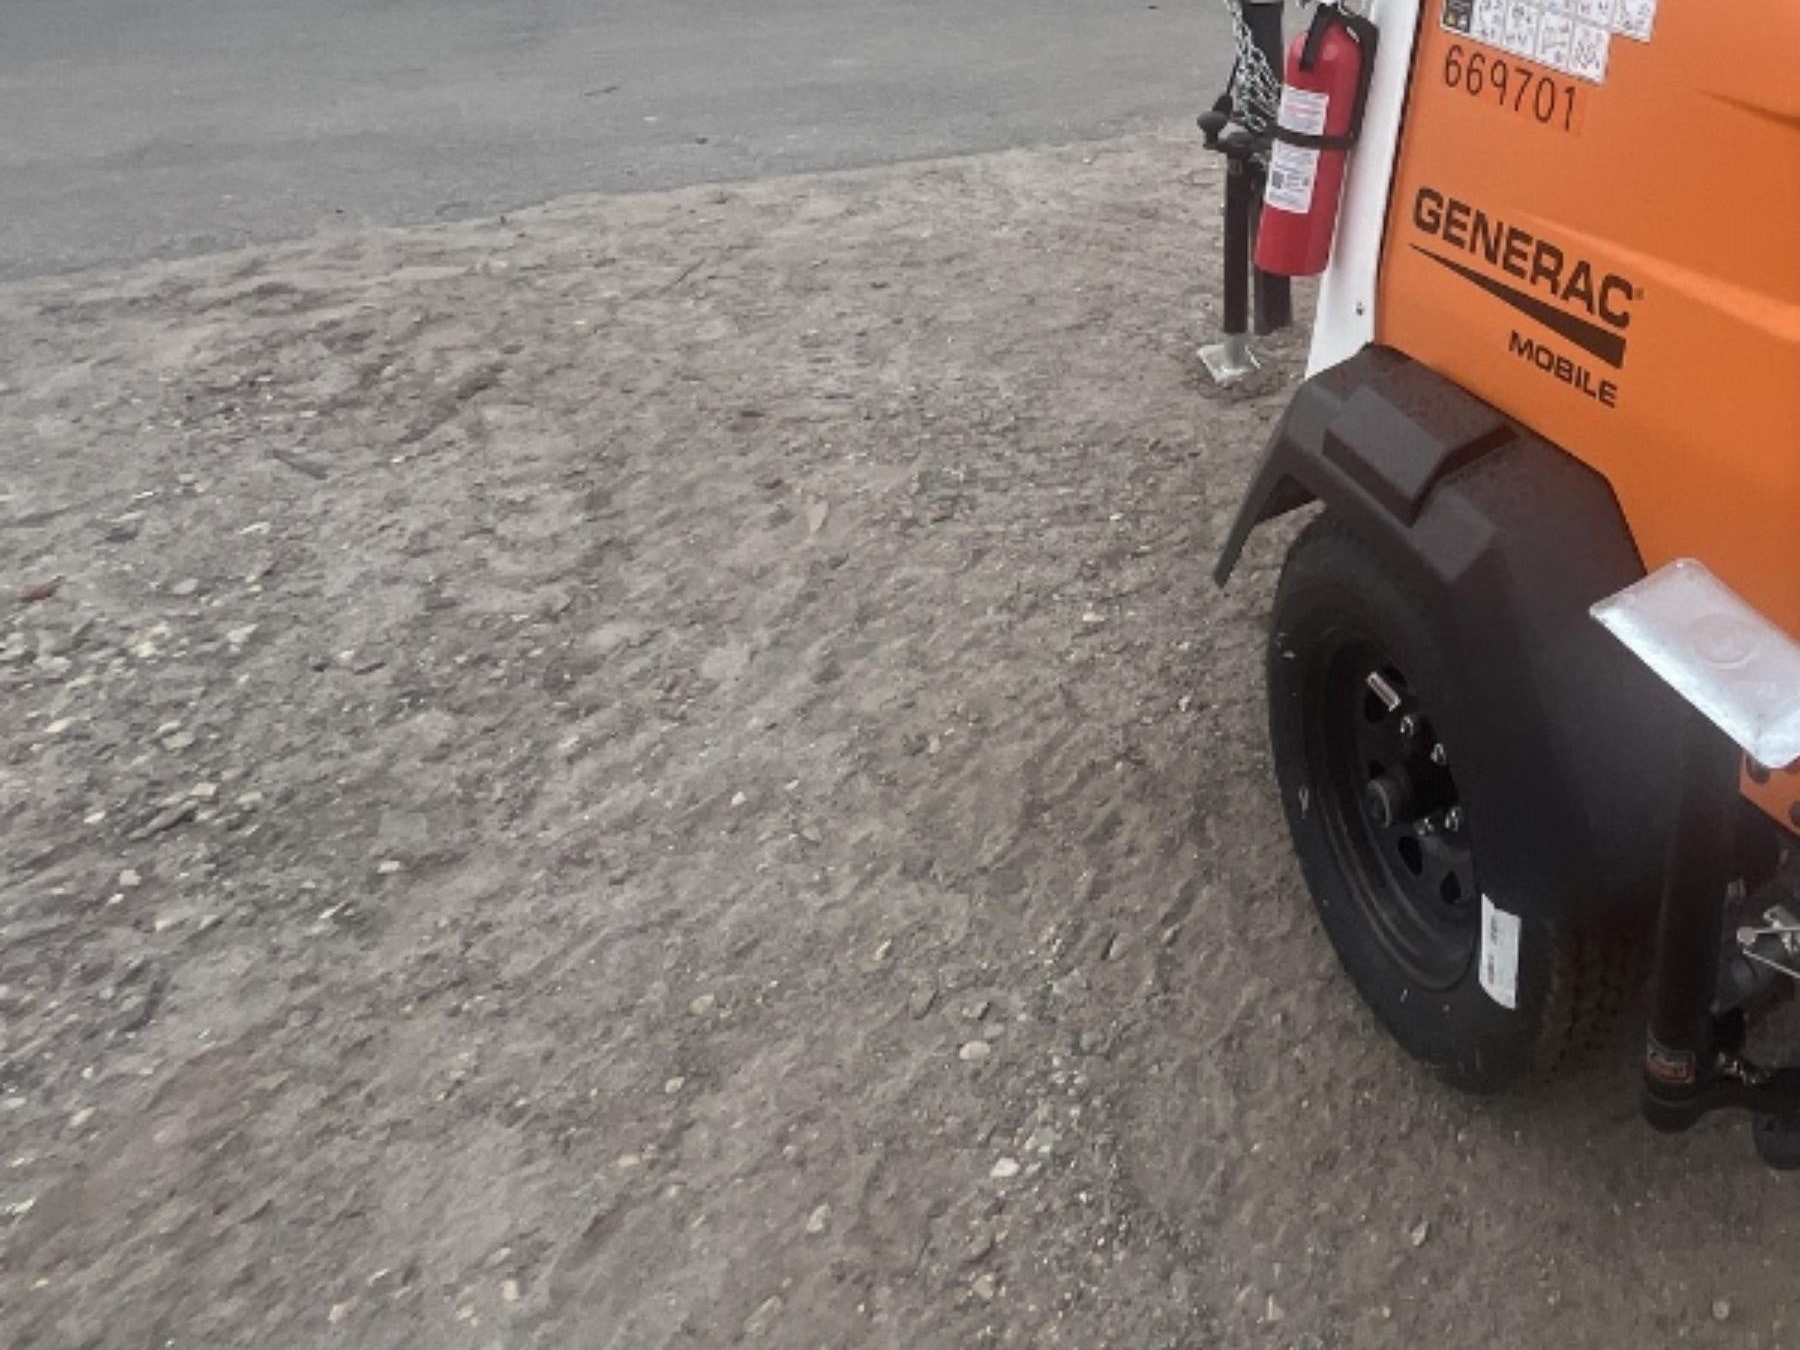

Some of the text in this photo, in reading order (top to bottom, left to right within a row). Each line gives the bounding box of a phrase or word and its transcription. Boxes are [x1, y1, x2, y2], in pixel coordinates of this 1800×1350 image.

[1444, 44, 1576, 132] 669701
[1413, 185, 1634, 330] GENERAC
[1508, 329, 1619, 408] MOBILE
